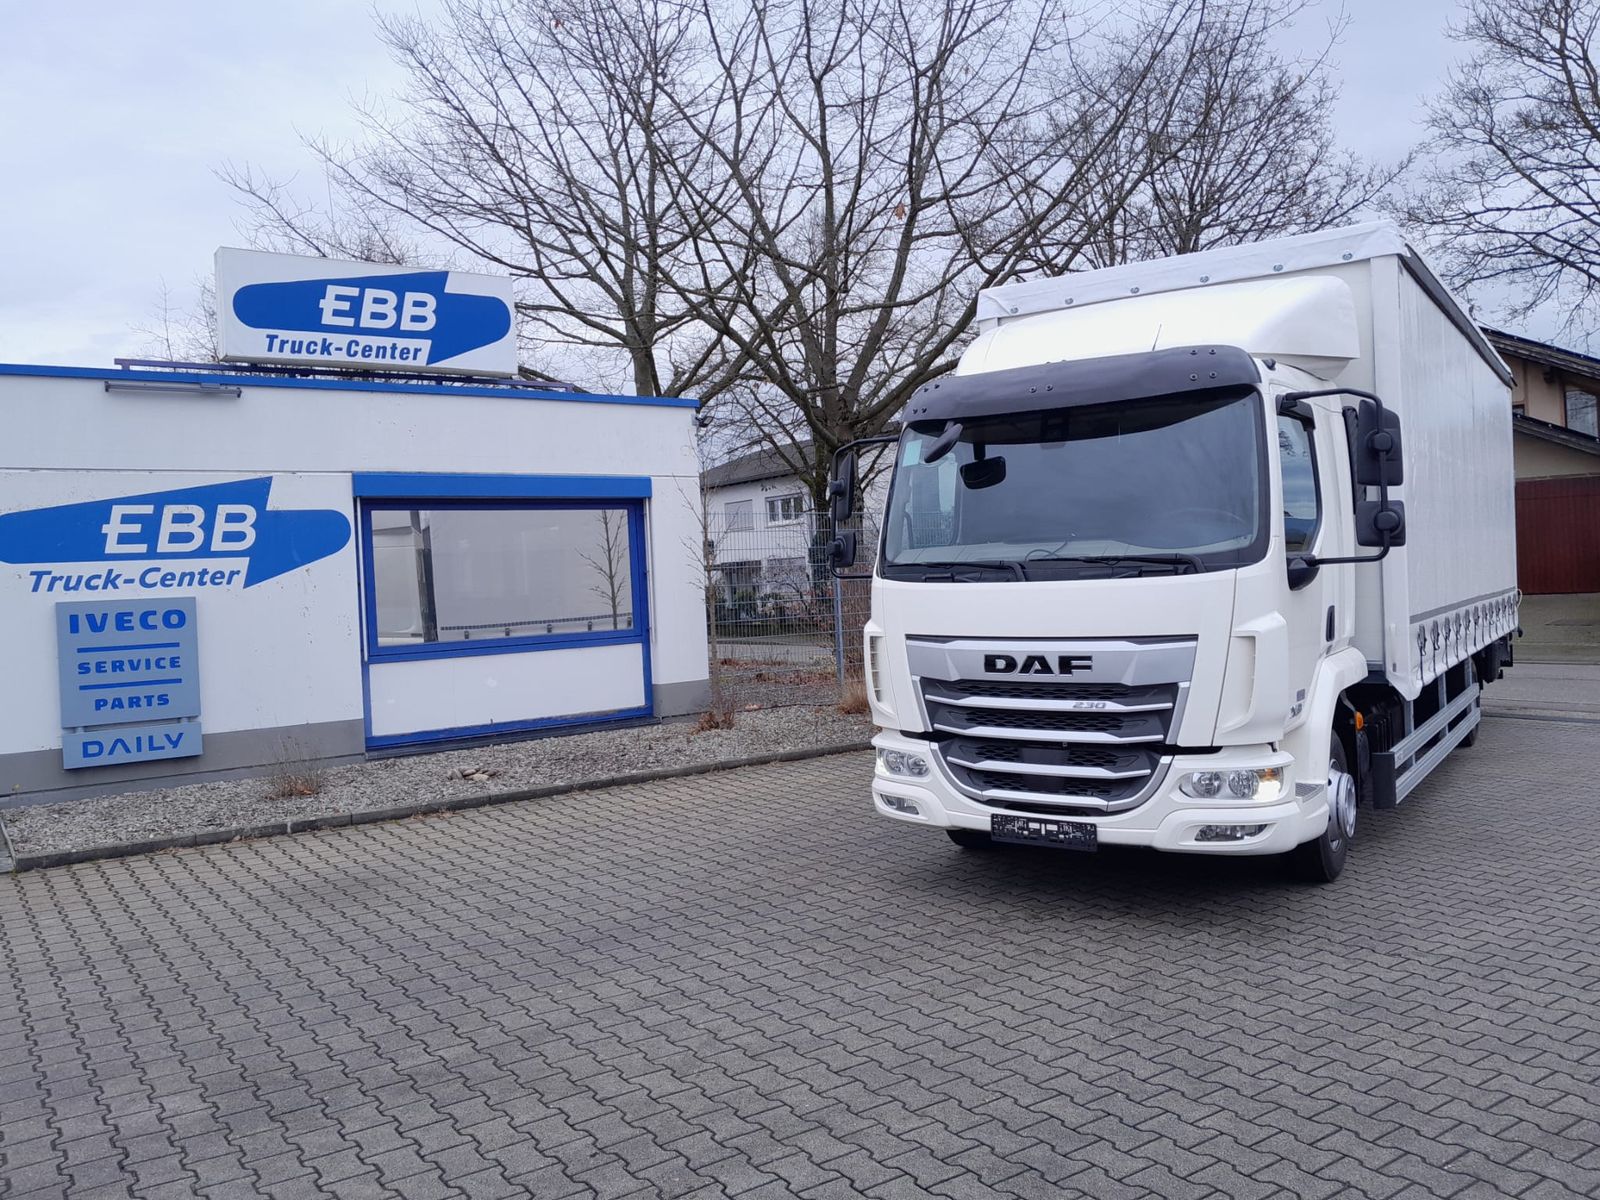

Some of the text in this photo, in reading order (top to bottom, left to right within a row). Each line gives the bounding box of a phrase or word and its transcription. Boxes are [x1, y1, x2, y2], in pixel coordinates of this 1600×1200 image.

[319, 284, 437, 332] EBB
[265, 334, 422, 362] Truck-Center
[101, 504, 257, 555] EBB
[29, 567, 241, 593] Truck-Center
[69, 609, 187, 635] IVECO
[77, 656, 182, 675] SERVICE
[983, 654, 1094, 677] DAF
[95, 693, 170, 711] PARTS
[82, 732, 185, 759] DAILY
